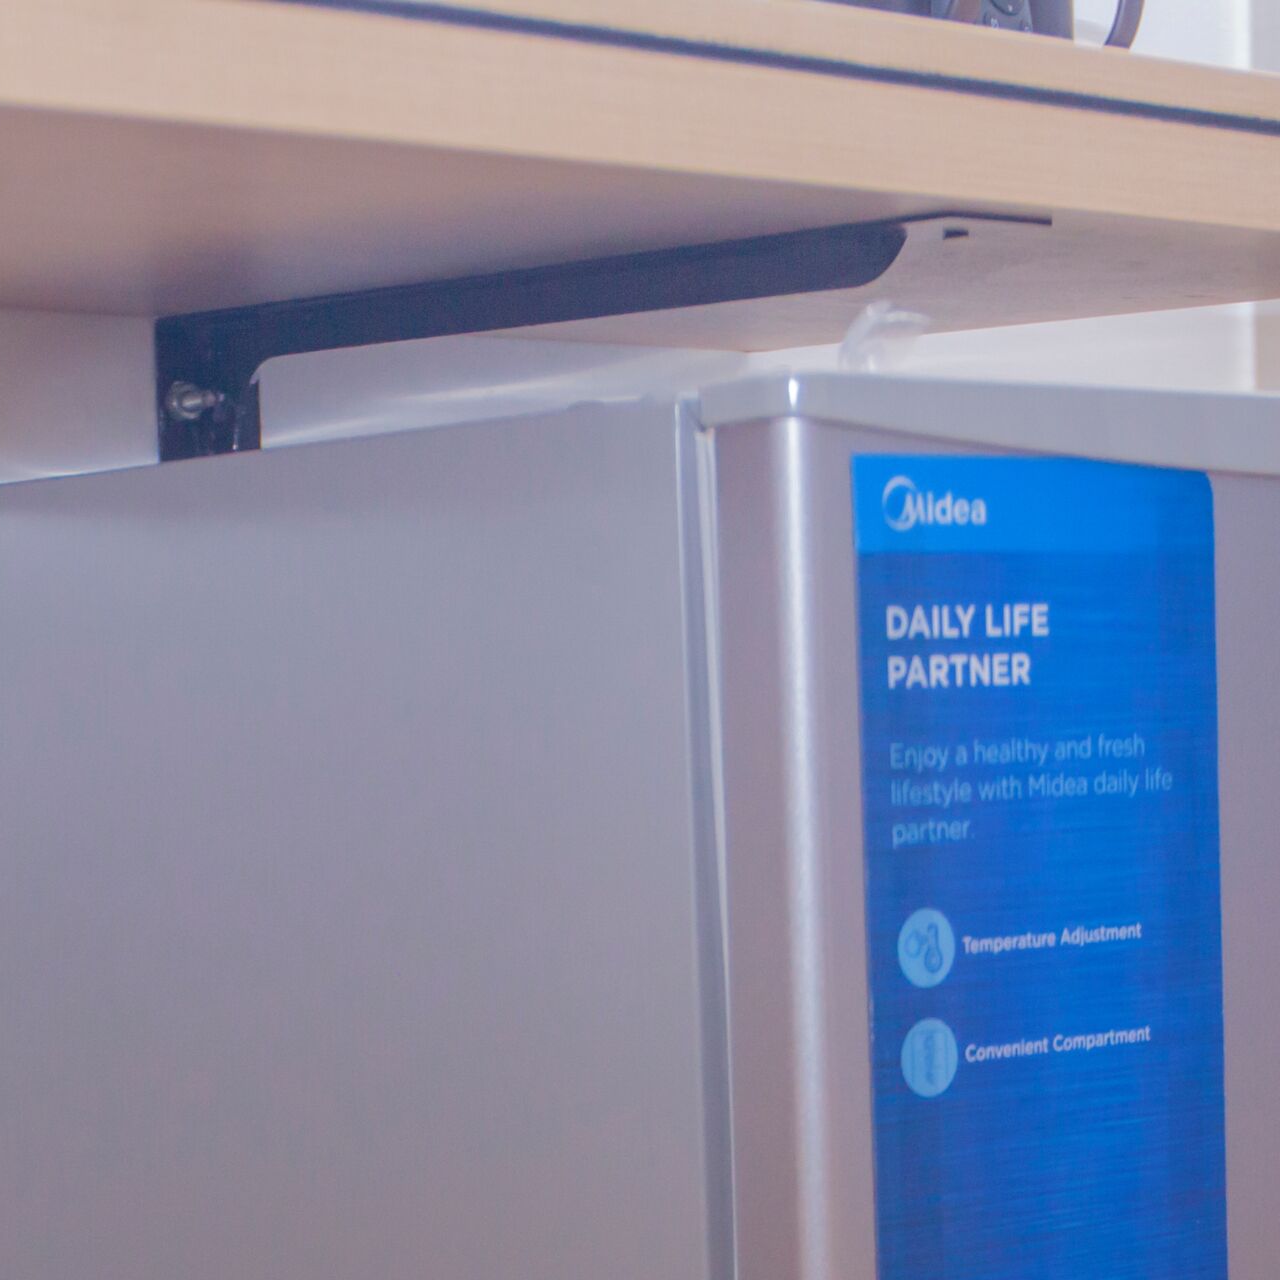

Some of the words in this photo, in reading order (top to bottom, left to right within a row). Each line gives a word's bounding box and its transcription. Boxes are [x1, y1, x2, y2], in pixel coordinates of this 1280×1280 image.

[882, 476, 987, 531] Midea
[886, 605, 975, 640] DAILY
[986, 604, 1049, 637] LIFE
[888, 654, 1031, 689] PARTNER
[890, 743, 948, 773] Enjoy
[955, 746, 968, 766] a
[974, 739, 1049, 766] healthy
[1055, 735, 1092, 761] and
[1099, 733, 1145, 758] fresh
[891, 777, 971, 809] lifestyle
[979, 773, 1022, 800] with
[1029, 769, 1088, 797] Midea
[1094, 767, 1139, 797] daily
[1145, 767, 1173, 791] life
[962, 932, 1056, 954] Temperature
[1060, 923, 1142, 948] Adjustment
[965, 1039, 1049, 1063] Convenient
[1053, 1026, 1151, 1052] Compartment
